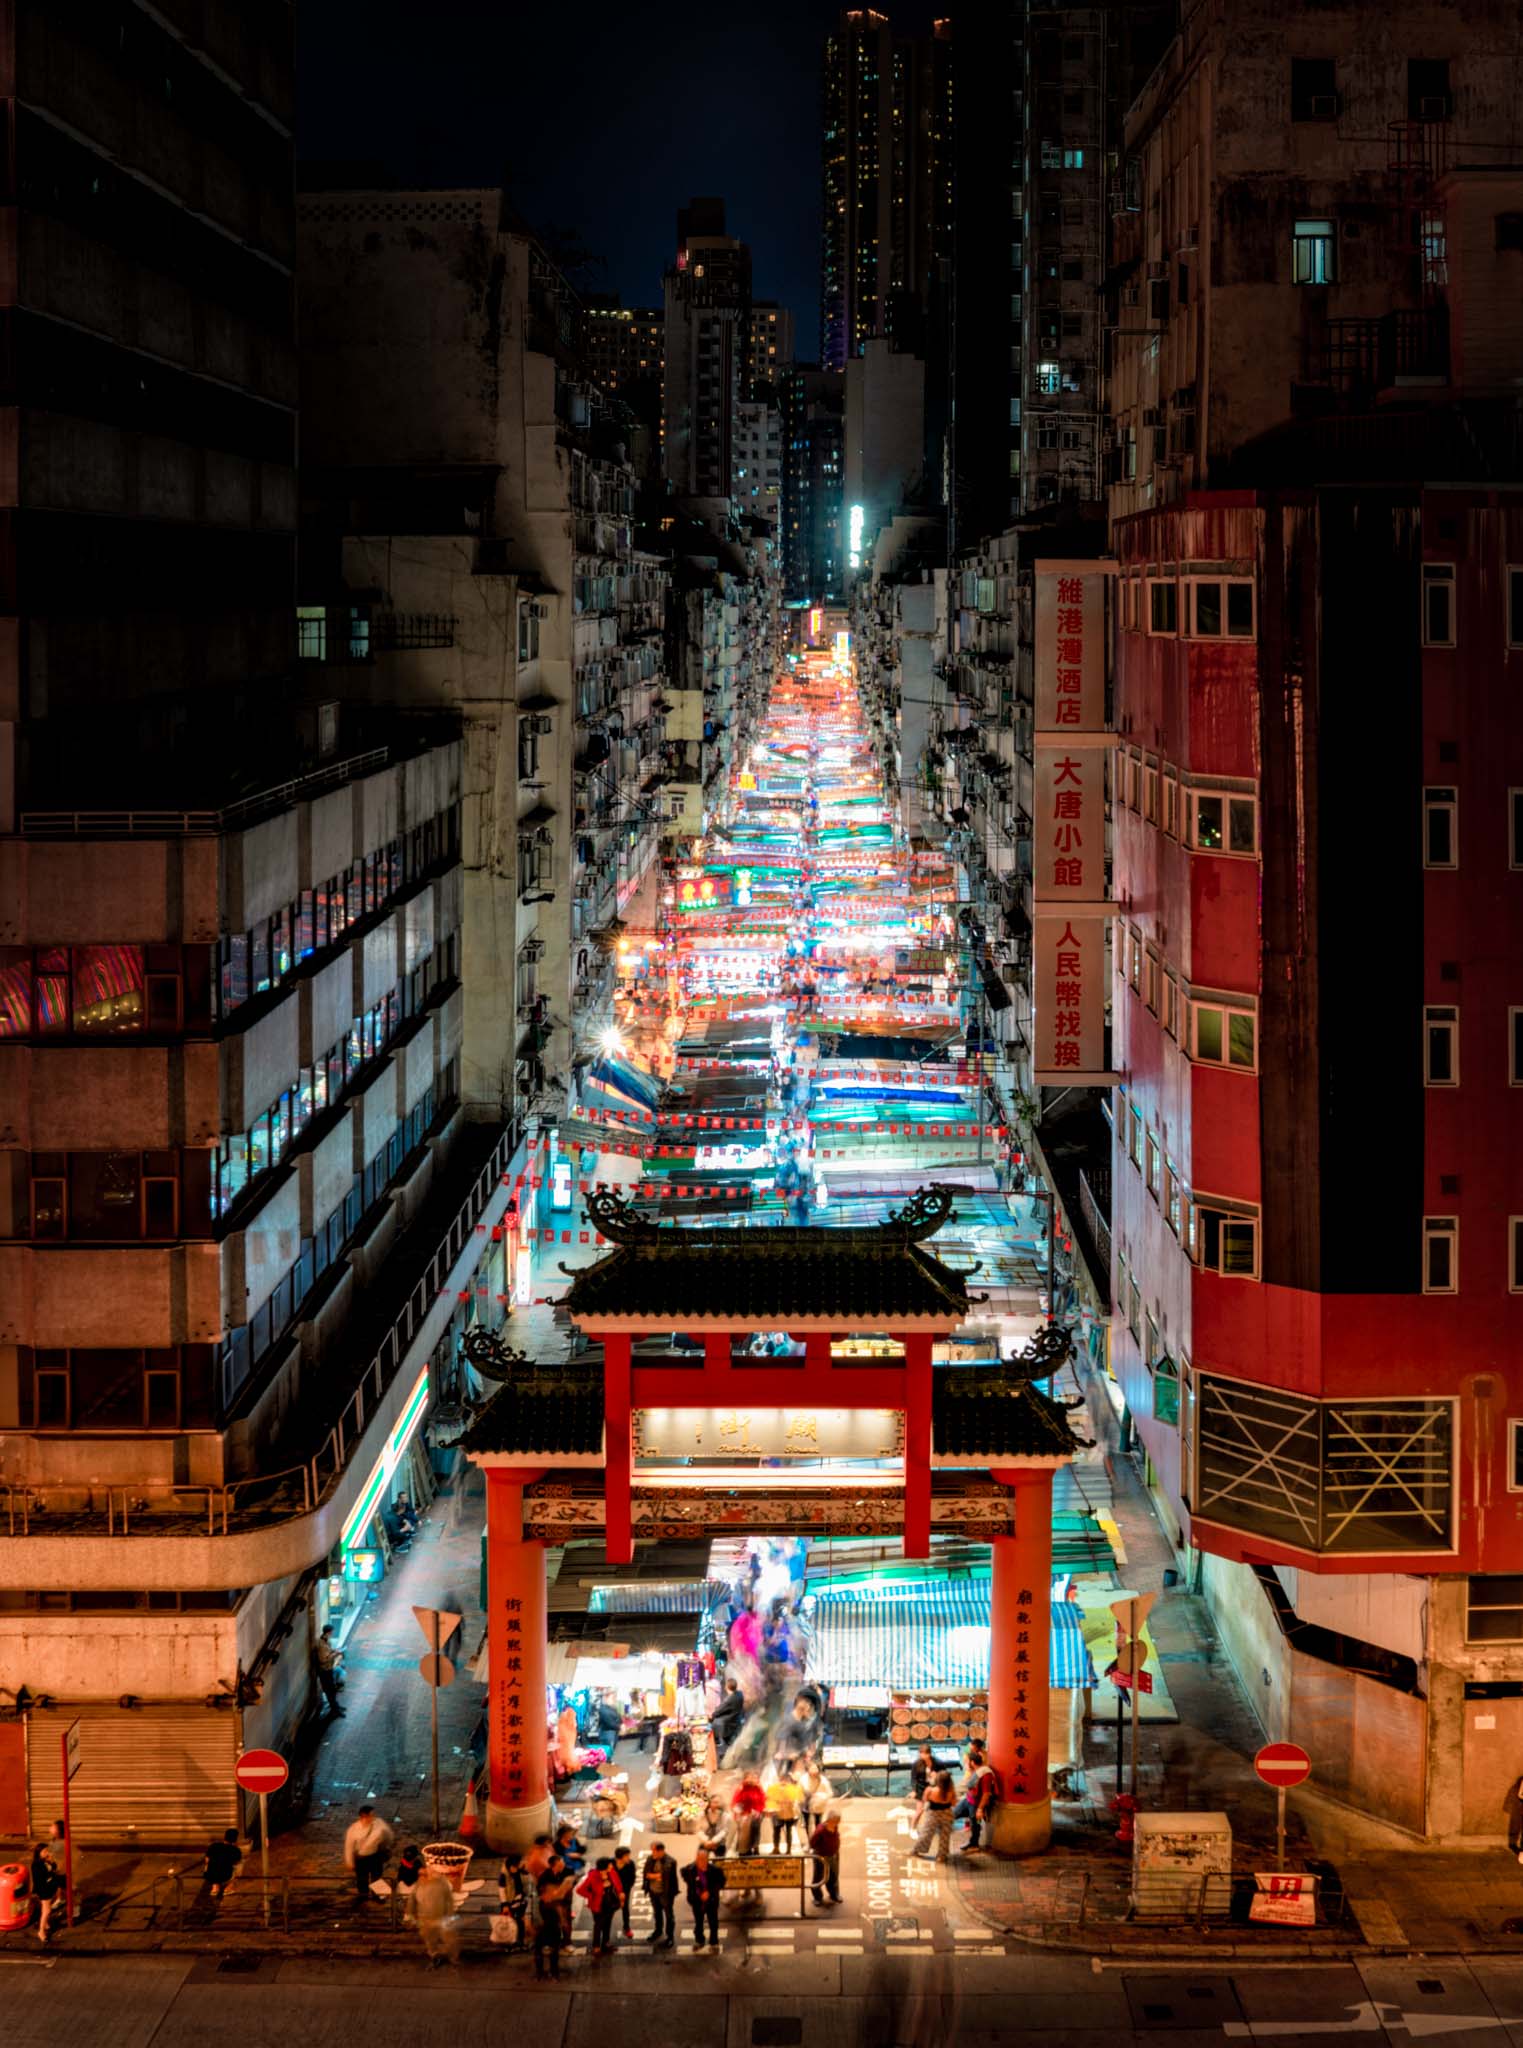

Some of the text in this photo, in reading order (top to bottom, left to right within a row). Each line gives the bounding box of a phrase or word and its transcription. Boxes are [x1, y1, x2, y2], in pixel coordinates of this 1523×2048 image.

[1055, 577, 1083, 725] 維港灣酒店
[1053, 756, 1083, 887] 大唐小館
[1054, 921, 1082, 1067] 人民幣找換
[865, 1838, 893, 1919] LOOK RIGHT
